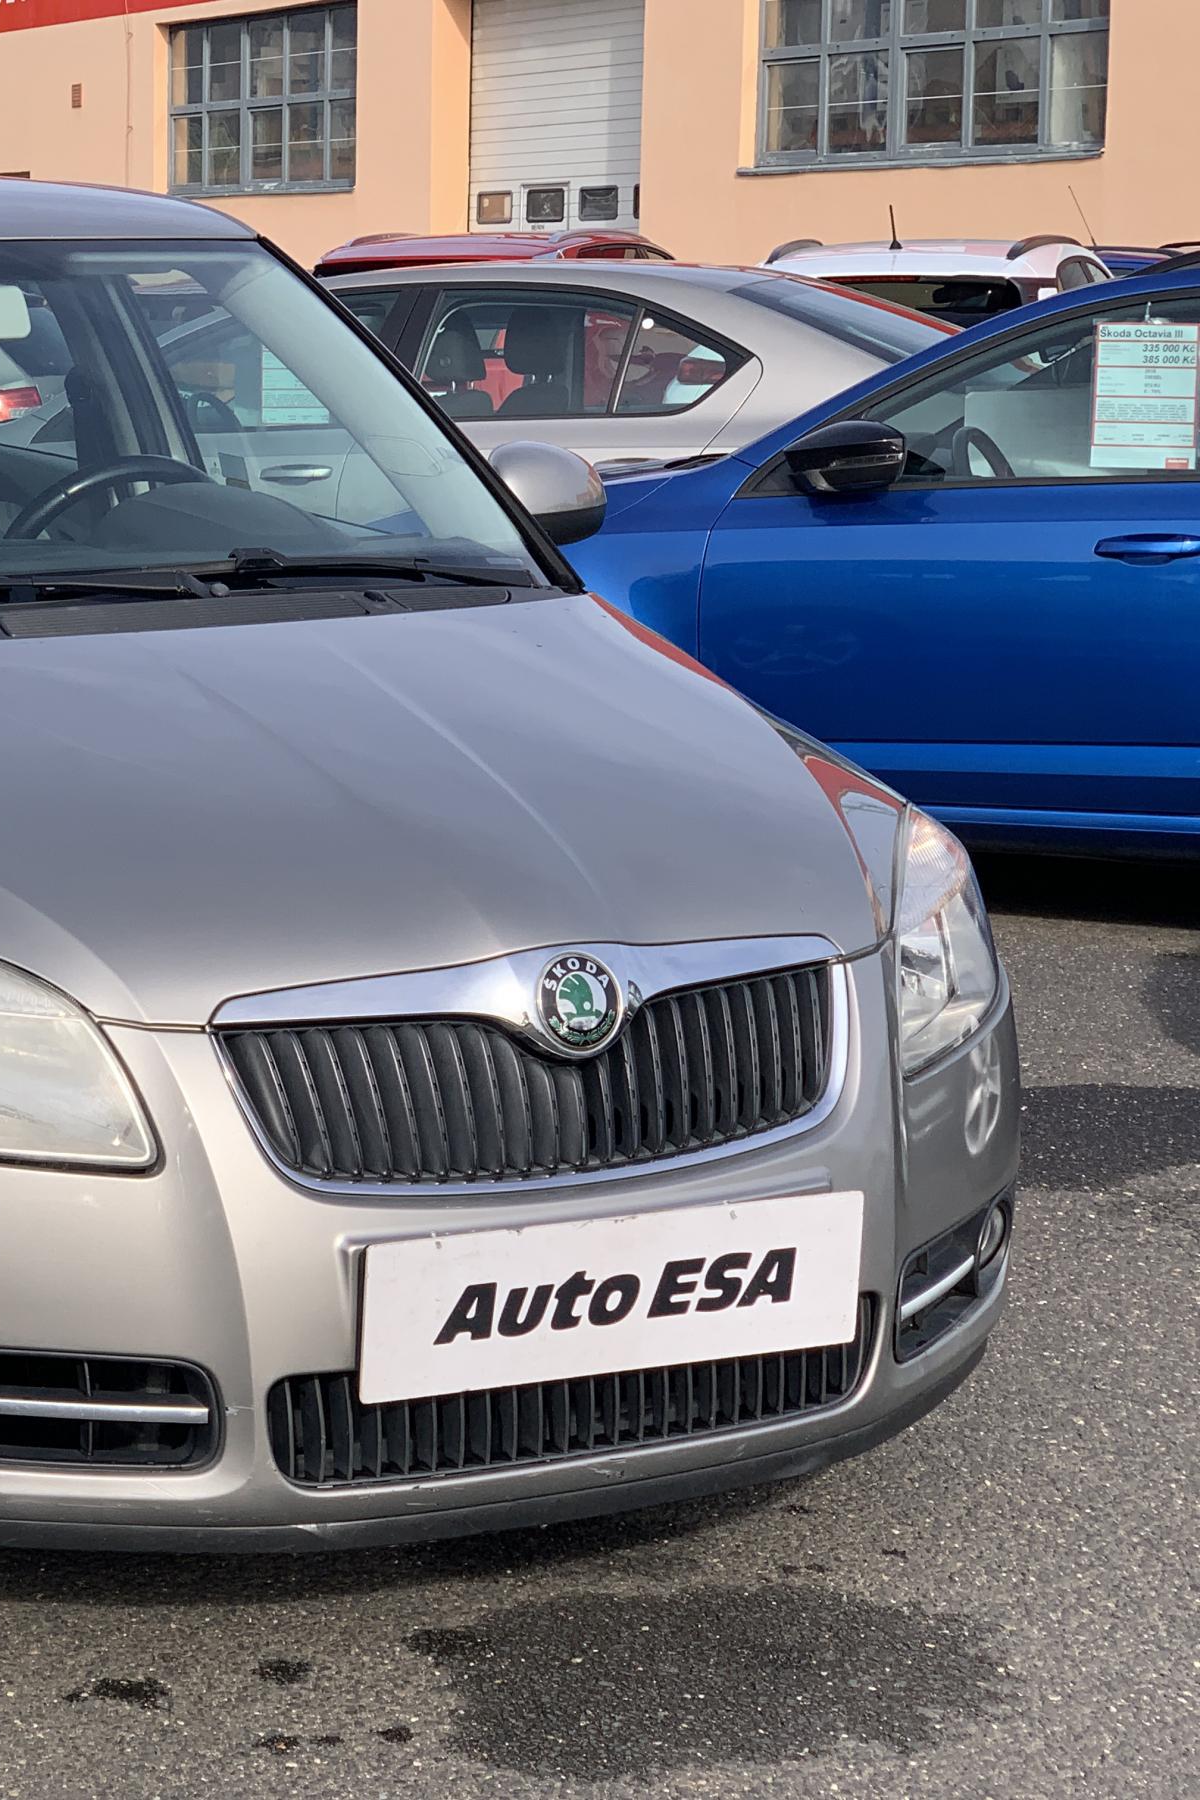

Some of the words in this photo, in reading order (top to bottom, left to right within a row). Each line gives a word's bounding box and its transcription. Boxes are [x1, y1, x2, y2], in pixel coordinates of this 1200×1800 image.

[1100, 326, 1132, 338] Škoda
[1134, 329, 1172, 338] Octavia
[1142, 344, 1160, 353] 335
[1162, 344, 1180, 353] 000
[1142, 355, 1160, 364] 385
[1162, 355, 1180, 364] 000
[432, 1270, 642, 1346] Auto
[646, 1246, 798, 1319] ESA
